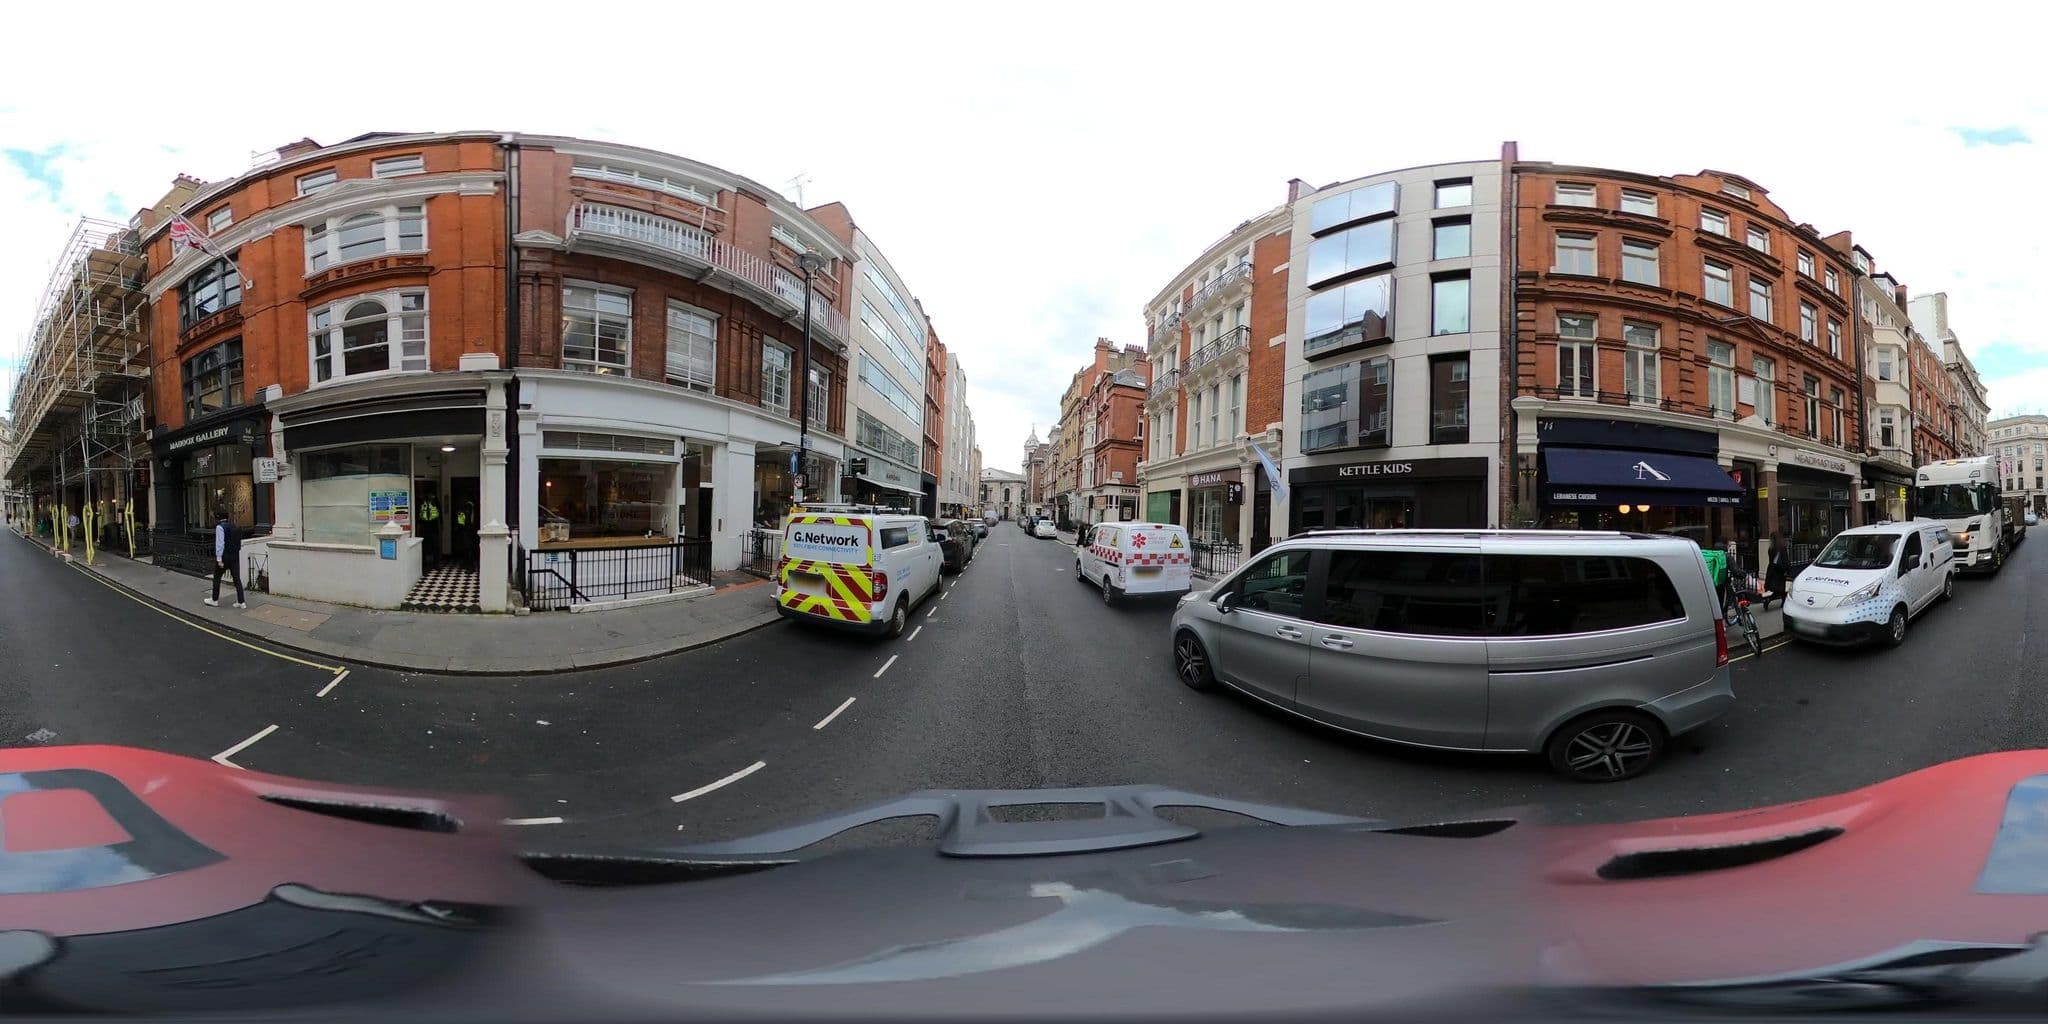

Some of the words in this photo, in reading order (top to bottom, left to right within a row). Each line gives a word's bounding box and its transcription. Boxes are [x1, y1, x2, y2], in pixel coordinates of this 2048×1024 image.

[169, 436, 195, 450] MADDOX
[195, 426, 229, 443] GALLERY
[1339, 464, 1381, 476] KETTLE
[1383, 463, 1412, 474] KIDS
[1200, 473, 1222, 484] HANA
[794, 531, 859, 547] G.Network
[818, 545, 858, 555] CONNECTIVITY
